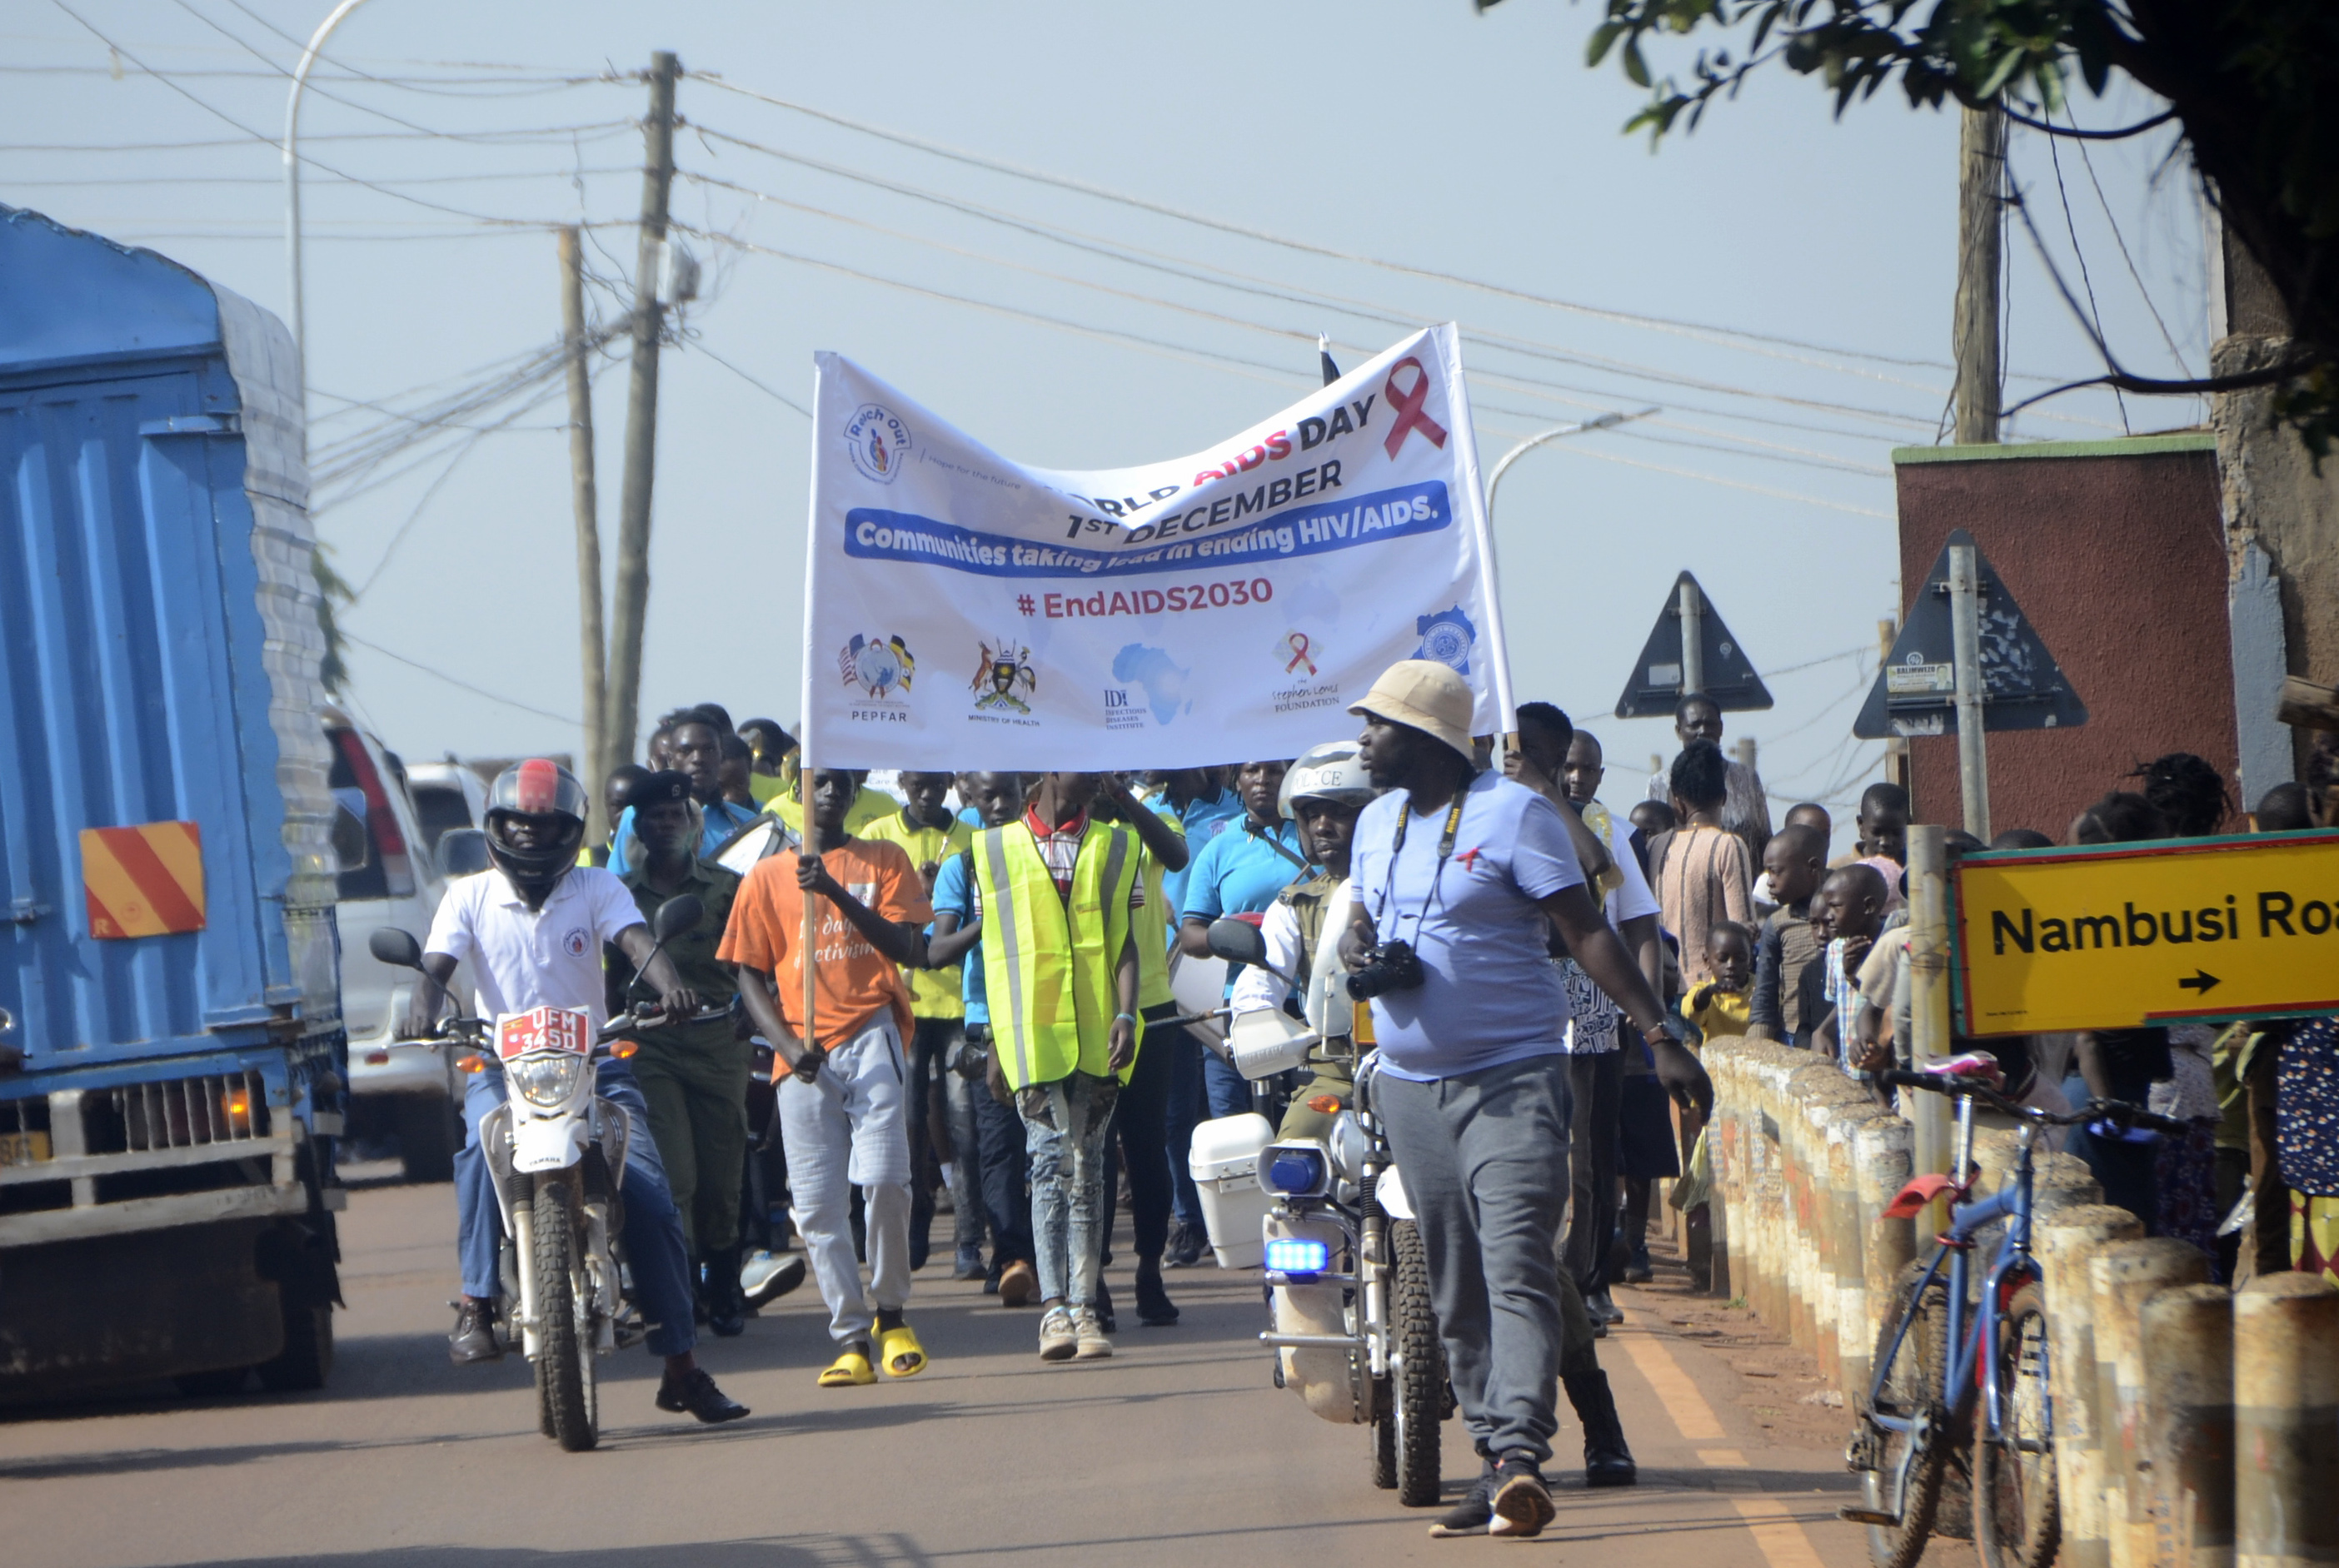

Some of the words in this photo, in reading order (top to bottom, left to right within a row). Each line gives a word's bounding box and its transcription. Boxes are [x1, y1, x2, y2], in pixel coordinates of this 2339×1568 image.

[887, 419, 906, 446] Out
[1193, 430, 1292, 487] AIDS
[1297, 393, 1376, 451] DAY
[929, 455, 955, 470] Hope
[957, 465, 970, 475] for
[972, 470, 988, 480] the
[990, 475, 1021, 490] future
[1066, 514, 1119, 539] 1ST
[1123, 459, 1342, 545] DECEMBER
[855, 521, 1006, 565] Communities
[1012, 544, 1102, 573] taking
[1105, 549, 1164, 570] lead
[1166, 544, 1191, 560] in
[1198, 525, 1294, 558] ending
[1299, 495, 1439, 545] HIV/AIDS.
[851, 710, 907, 723] PEPFAR
[1105, 707, 1147, 716] INFECTIOUS
[1274, 696, 1339, 713] FOUNDATION
[968, 714, 1000, 724] MINISTRY
[1013, 719, 1040, 727] HEALTH
[1105, 715, 1139, 724] DISEASES
[1106, 722, 1144, 730] INSTITUTE
[1991, 894, 2238, 956] Nambusi
[2257, 891, 2339, 938] Ro
[532, 1008, 576, 1032] UFM
[521, 1028, 576, 1053] 345D
